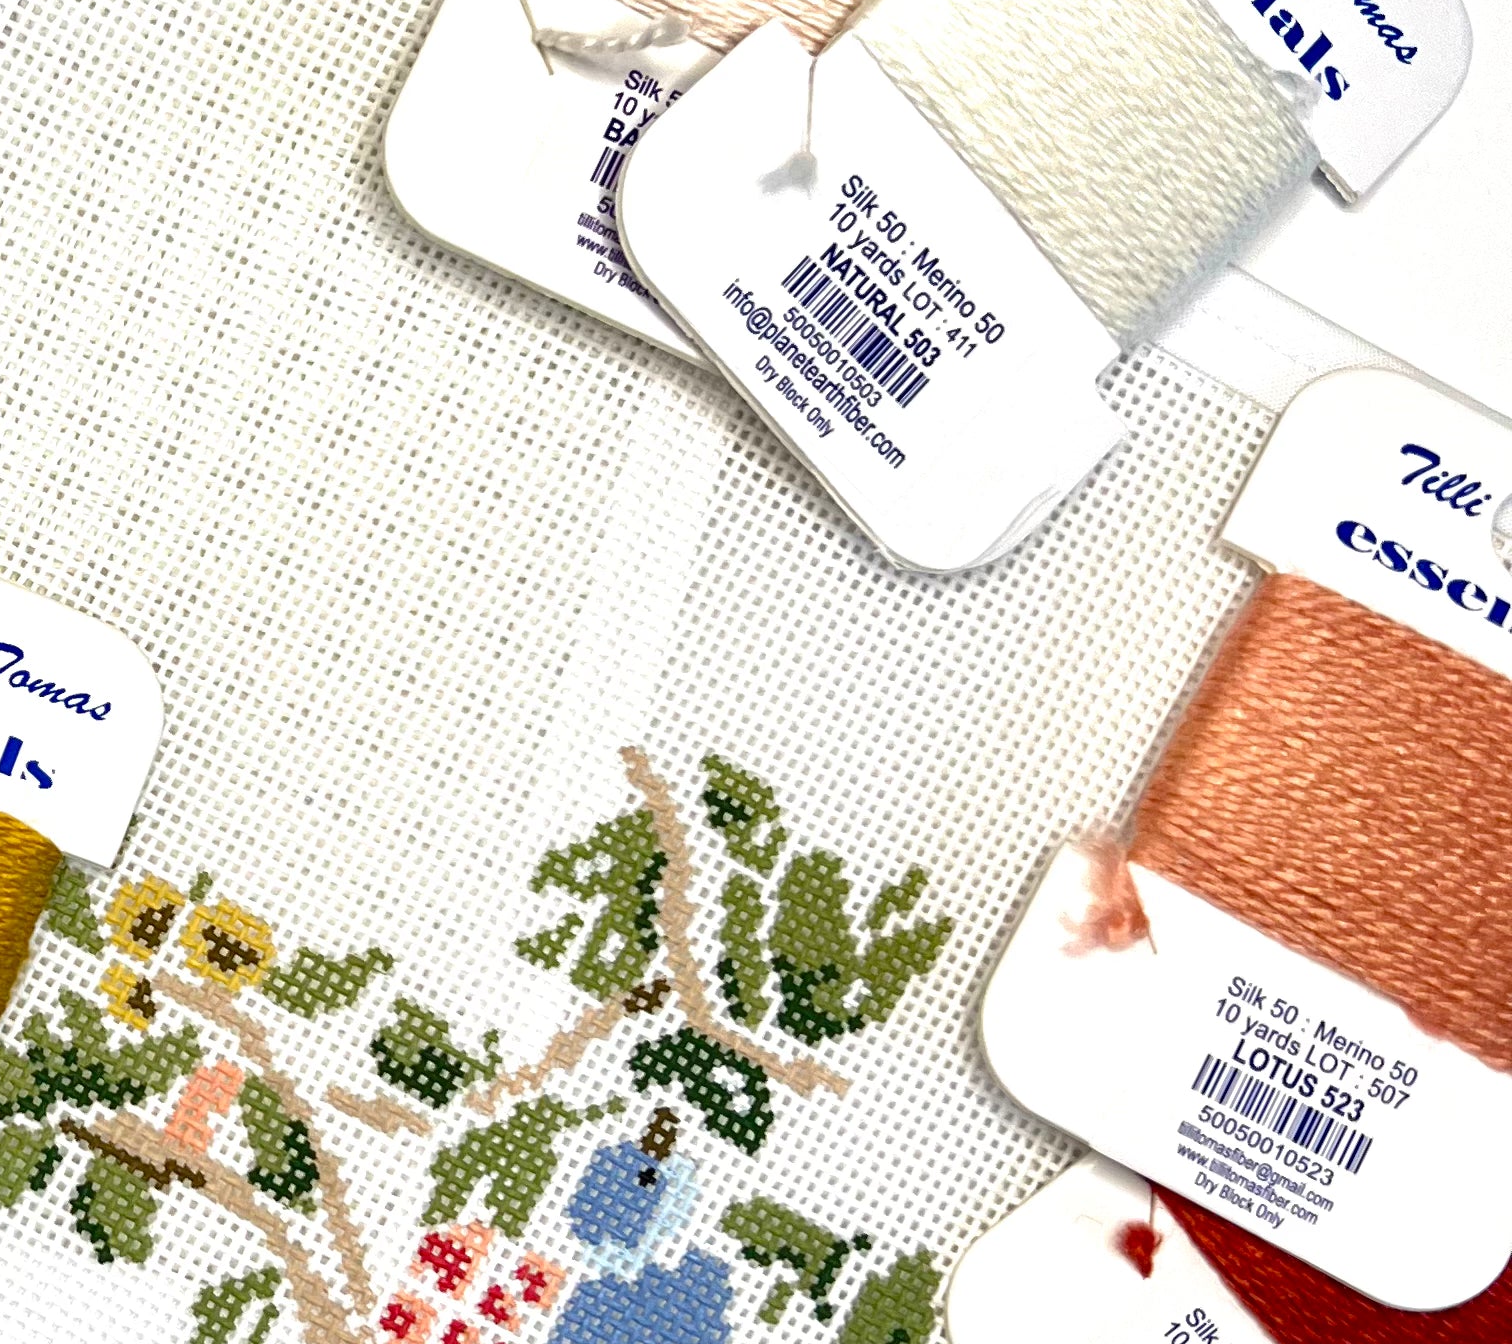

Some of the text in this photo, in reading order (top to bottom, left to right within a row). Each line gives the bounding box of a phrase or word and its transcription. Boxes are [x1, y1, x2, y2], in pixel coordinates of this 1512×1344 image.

[613, 91, 639, 117] 10
[624, 69, 663, 103] Silk
[829, 203, 978, 359] 10 yards LOT 411
[841, 175, 1006, 345] Silk 50 Merino 50
[820, 242, 942, 368] NATURAL 503
[755, 356, 835, 438] Dry Block Only
[783, 306, 883, 408] 50050010503
[1400, 443, 1492, 517] Tilli
[1216, 998, 1411, 1109] 10 yards LOT 507
[1228, 976, 1419, 1087] Silk 50 Merino 50
[1232, 1040, 1366, 1123] LOTUS 523
[1198, 1105, 1335, 1187] 50050010523
[1194, 1171, 1285, 1230] Dry Block Only
